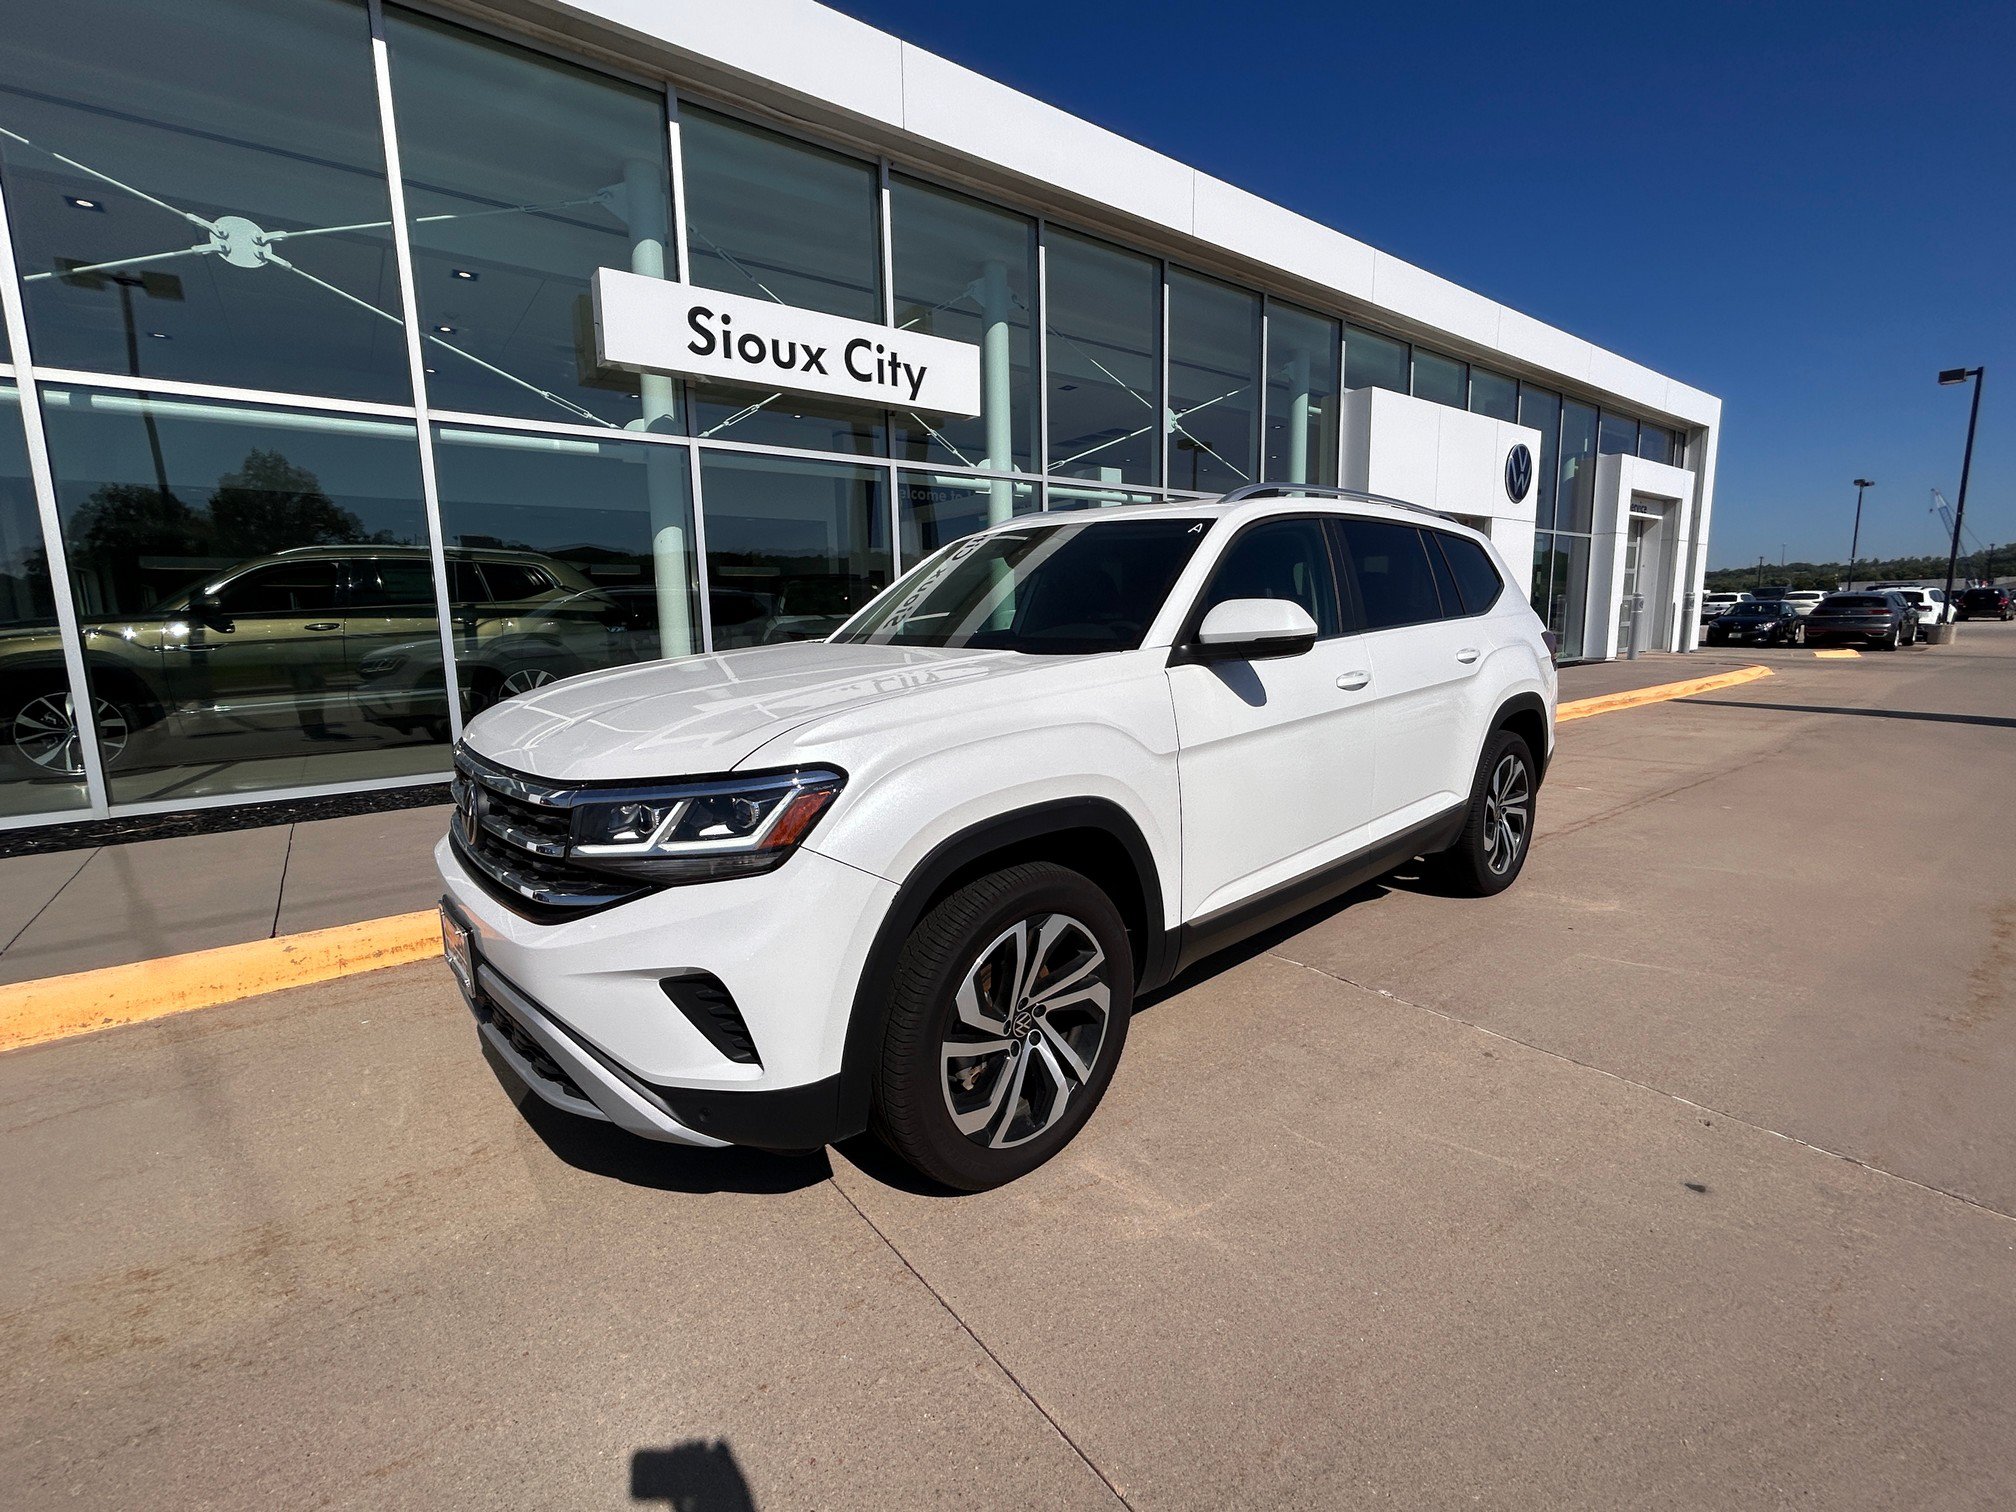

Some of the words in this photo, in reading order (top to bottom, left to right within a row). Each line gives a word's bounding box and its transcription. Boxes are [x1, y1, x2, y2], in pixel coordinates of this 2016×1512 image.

[687, 306, 829, 375] Sioux
[844, 338, 928, 401] City
[899, 487, 946, 501] elcome
[1631, 501, 1648, 513] ervice
